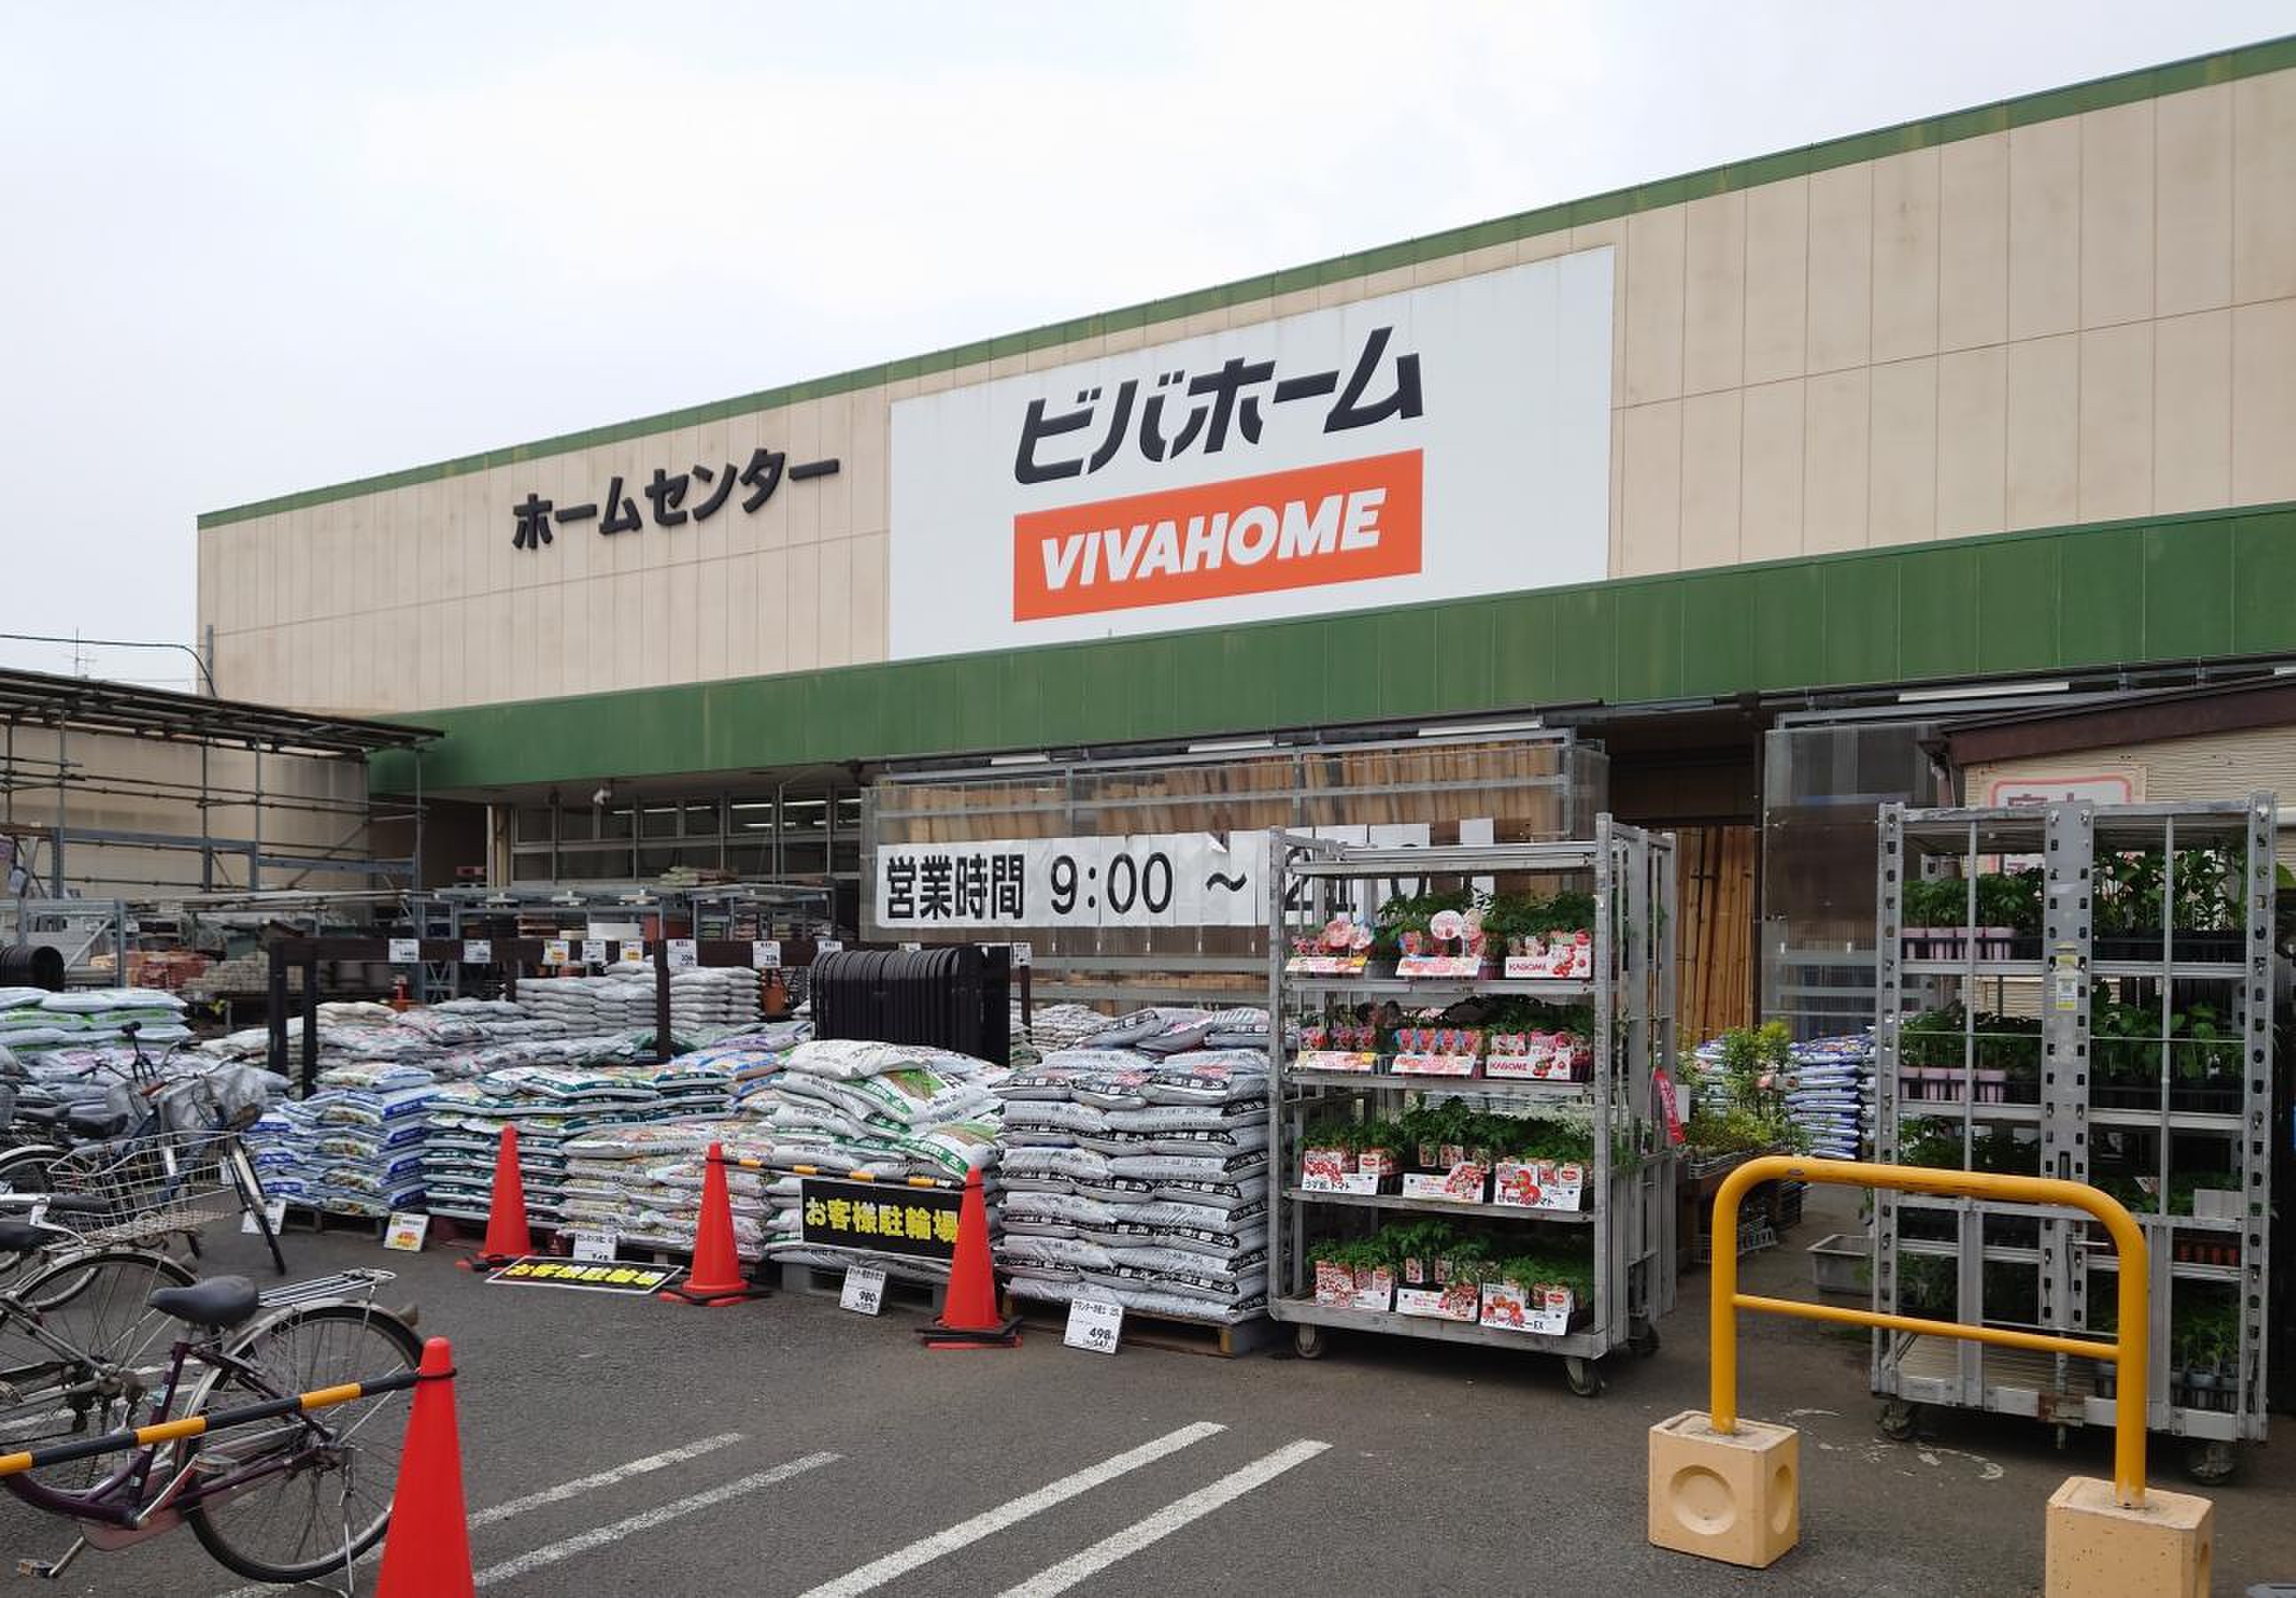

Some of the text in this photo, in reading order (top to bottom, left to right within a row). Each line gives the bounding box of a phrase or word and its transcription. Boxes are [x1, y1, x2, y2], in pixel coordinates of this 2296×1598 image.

[1015, 326, 1423, 485] ビバホーム
[512, 447, 840, 550] ホームセンター
[1041, 487, 1386, 590] VIVAHOME
[888, 853, 1025, 920] 営業時間
[1050, 851, 1174, 915] 9:00
[805, 1197, 959, 1243] お客様駐輪場
